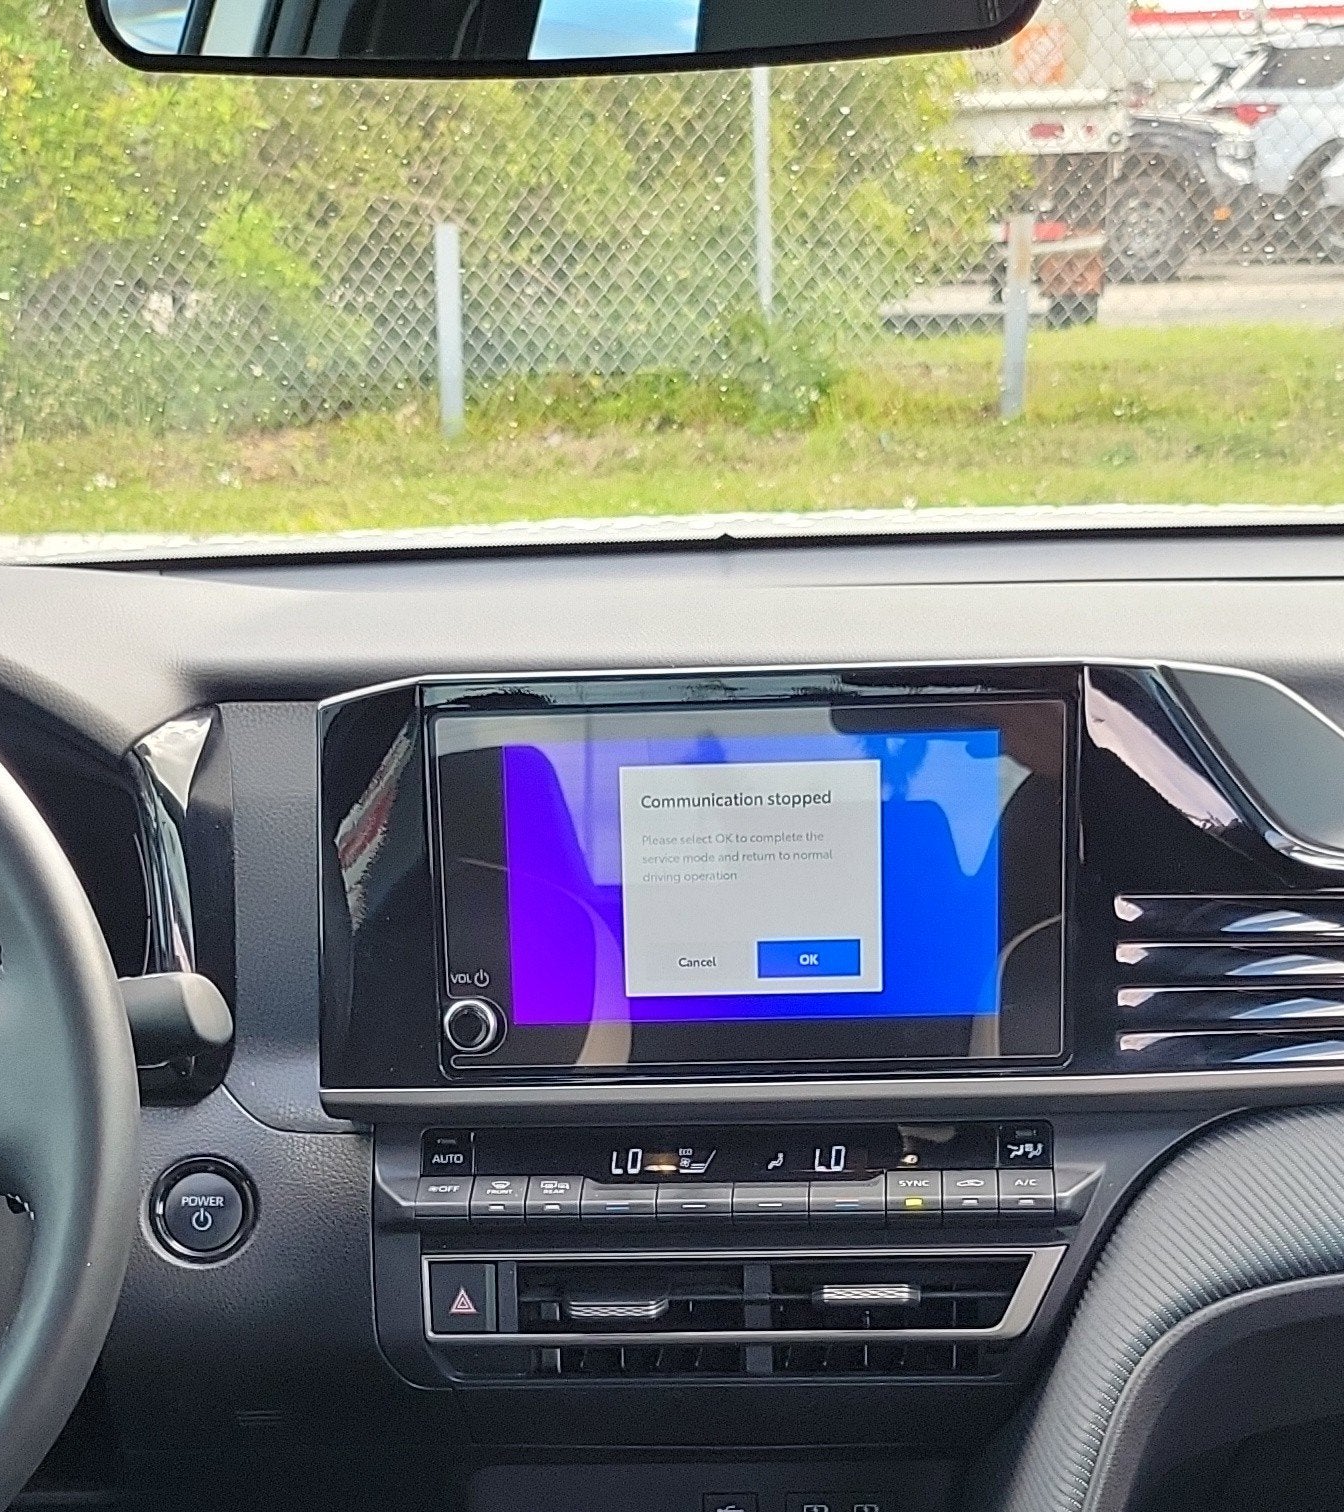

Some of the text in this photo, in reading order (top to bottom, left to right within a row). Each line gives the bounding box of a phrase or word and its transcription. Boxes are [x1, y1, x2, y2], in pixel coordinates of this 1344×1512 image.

[641, 791, 832, 809] Communication stopped
[642, 831, 824, 845] Please select OK to complete the
[642, 849, 833, 864] service mode and return to normal
[643, 871, 737, 884] driving operation
[678, 956, 717, 967] Cancel
[799, 954, 819, 965] OK
[450, 973, 472, 983] VOL
[432, 1154, 463, 1164] AUTO
[438, 1185, 460, 1193] OFF
[181, 1196, 224, 1207] POWER
